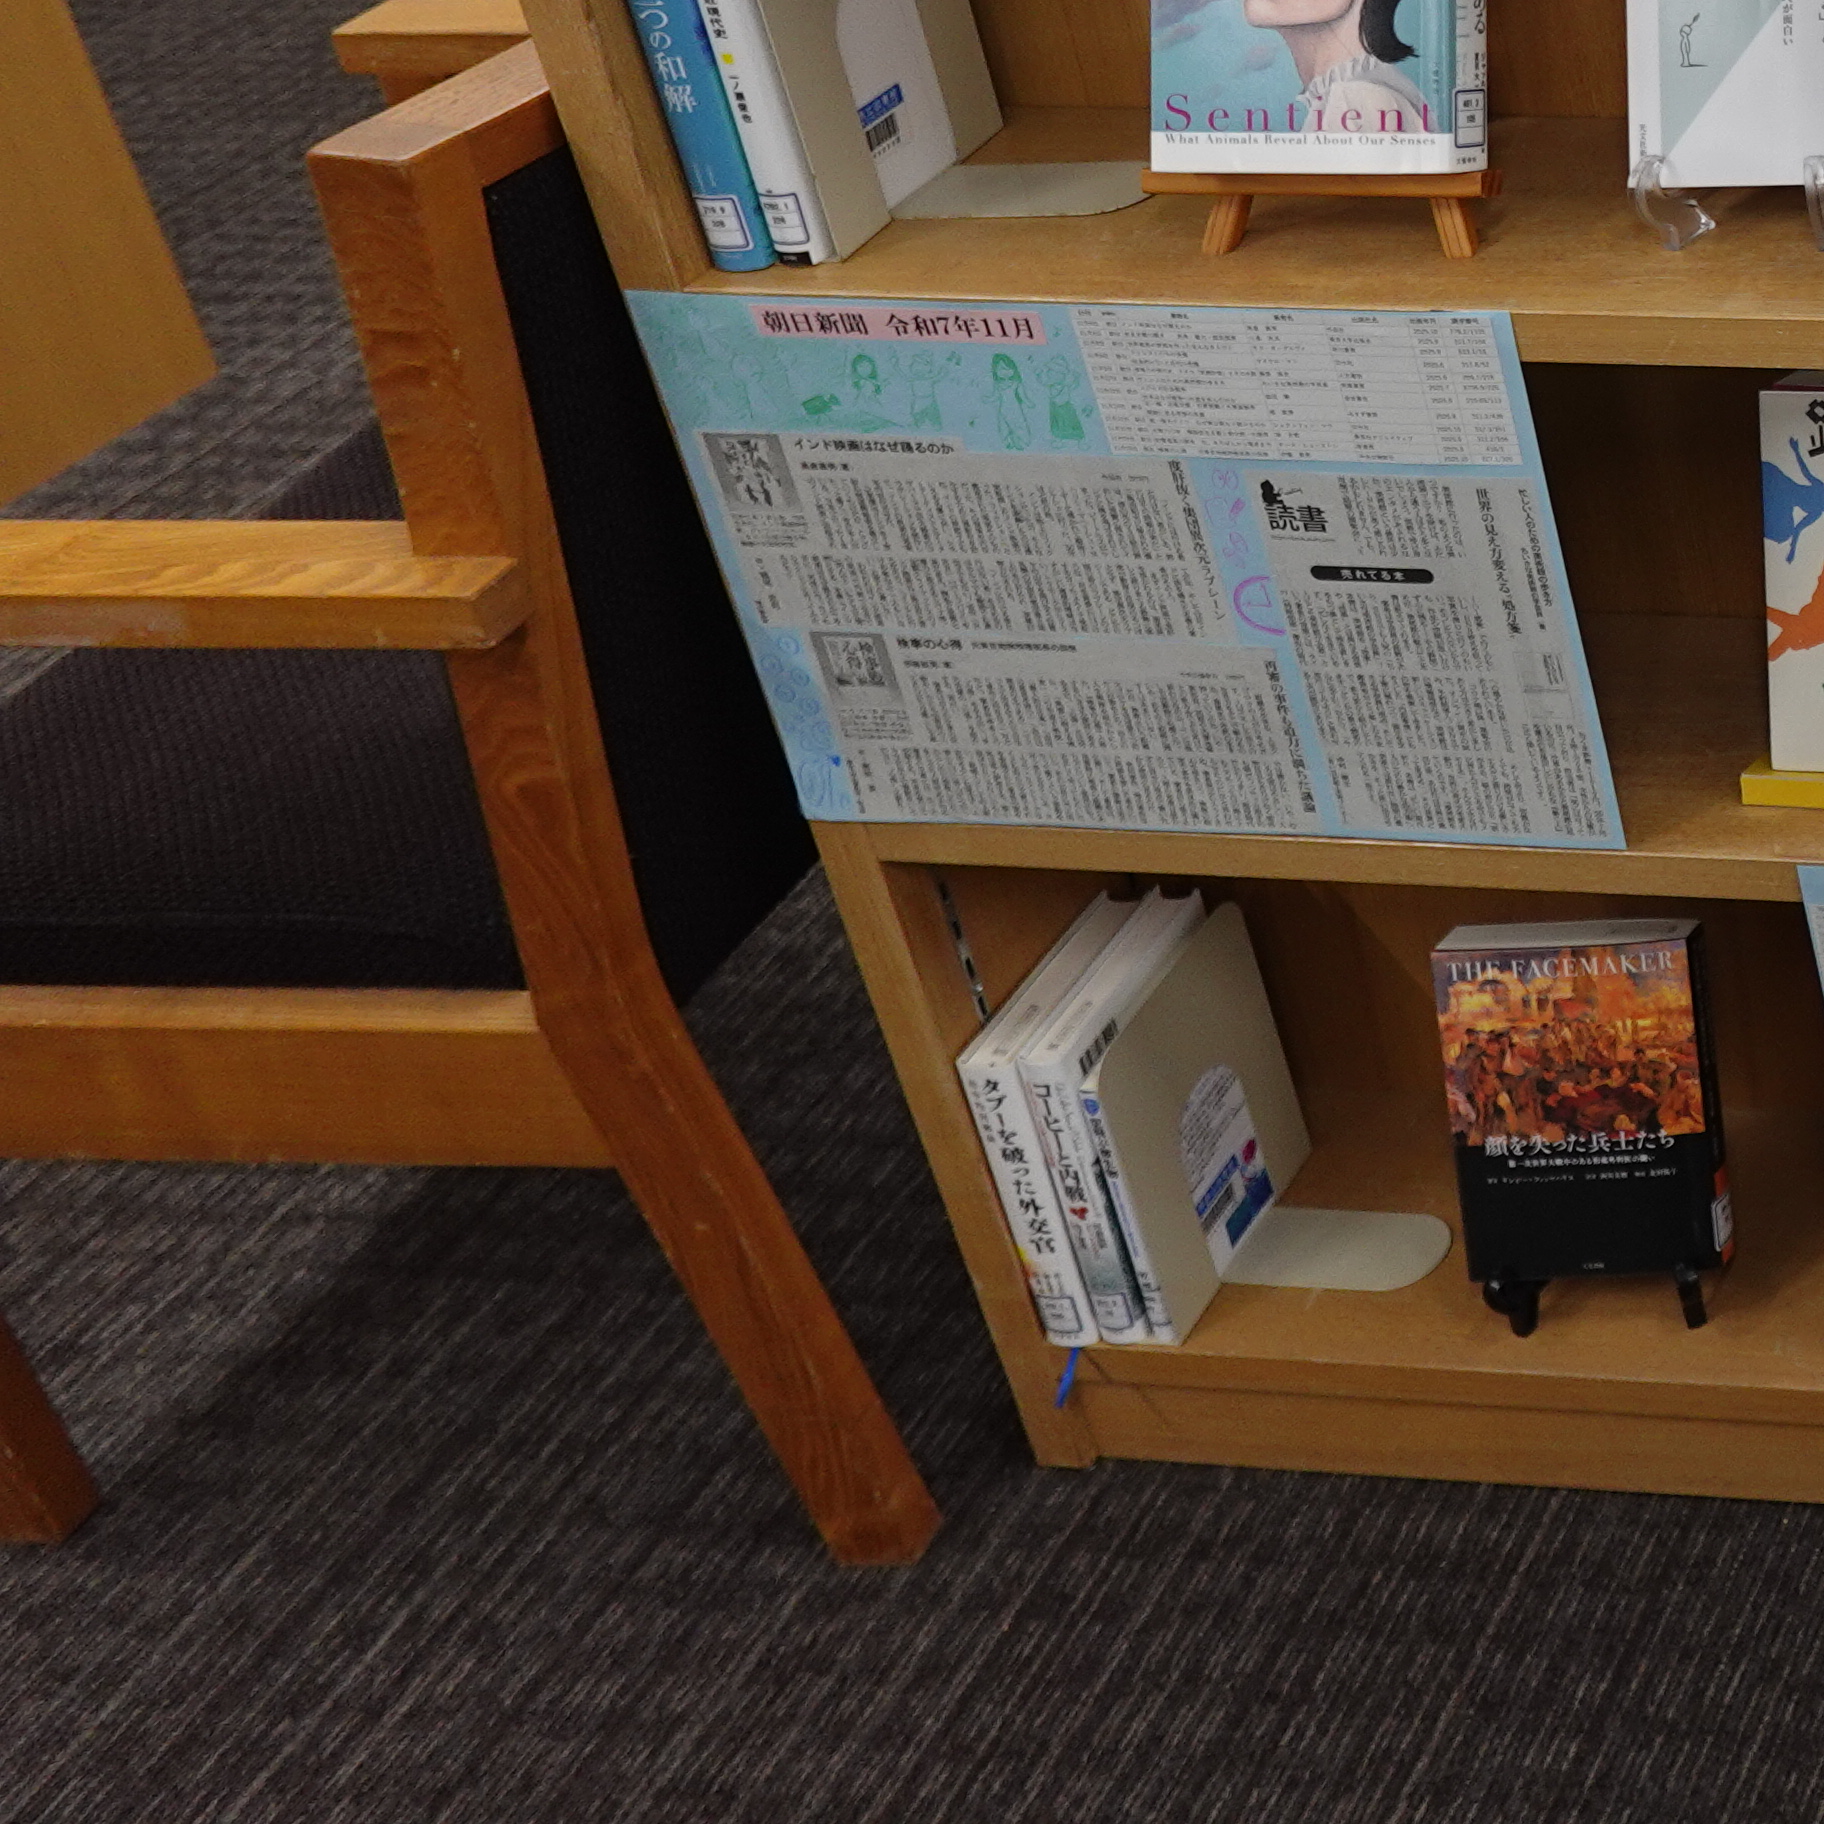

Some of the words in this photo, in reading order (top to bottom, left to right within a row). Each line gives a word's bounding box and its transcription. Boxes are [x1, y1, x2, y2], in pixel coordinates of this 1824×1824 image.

[1164, 93, 1434, 133] Sentient
[1164, 133, 1200, 146] What
[1205, 133, 1259, 146] Animals
[1264, 133, 1309, 146] Reveal
[1312, 133, 1354, 146] About
[1358, 133, 1385, 146] Our
[1389, 133, 1436, 147] Senses
[760, 307, 870, 337] 朝日新聞
[884, 310, 1036, 341] 令和7年11月
[1264, 503, 1330, 535] 読書
[896, 636, 964, 651] 検事の心得
[1446, 958, 1501, 982] THE
[1511, 950, 1676, 980] FACEMAKER
[1032, 1083, 1088, 1203] コーヒーと内戦
[1484, 1129, 1676, 1158] 顔を失った兵士たち
[982, 1078, 1057, 1255] タブーを破った外交官
